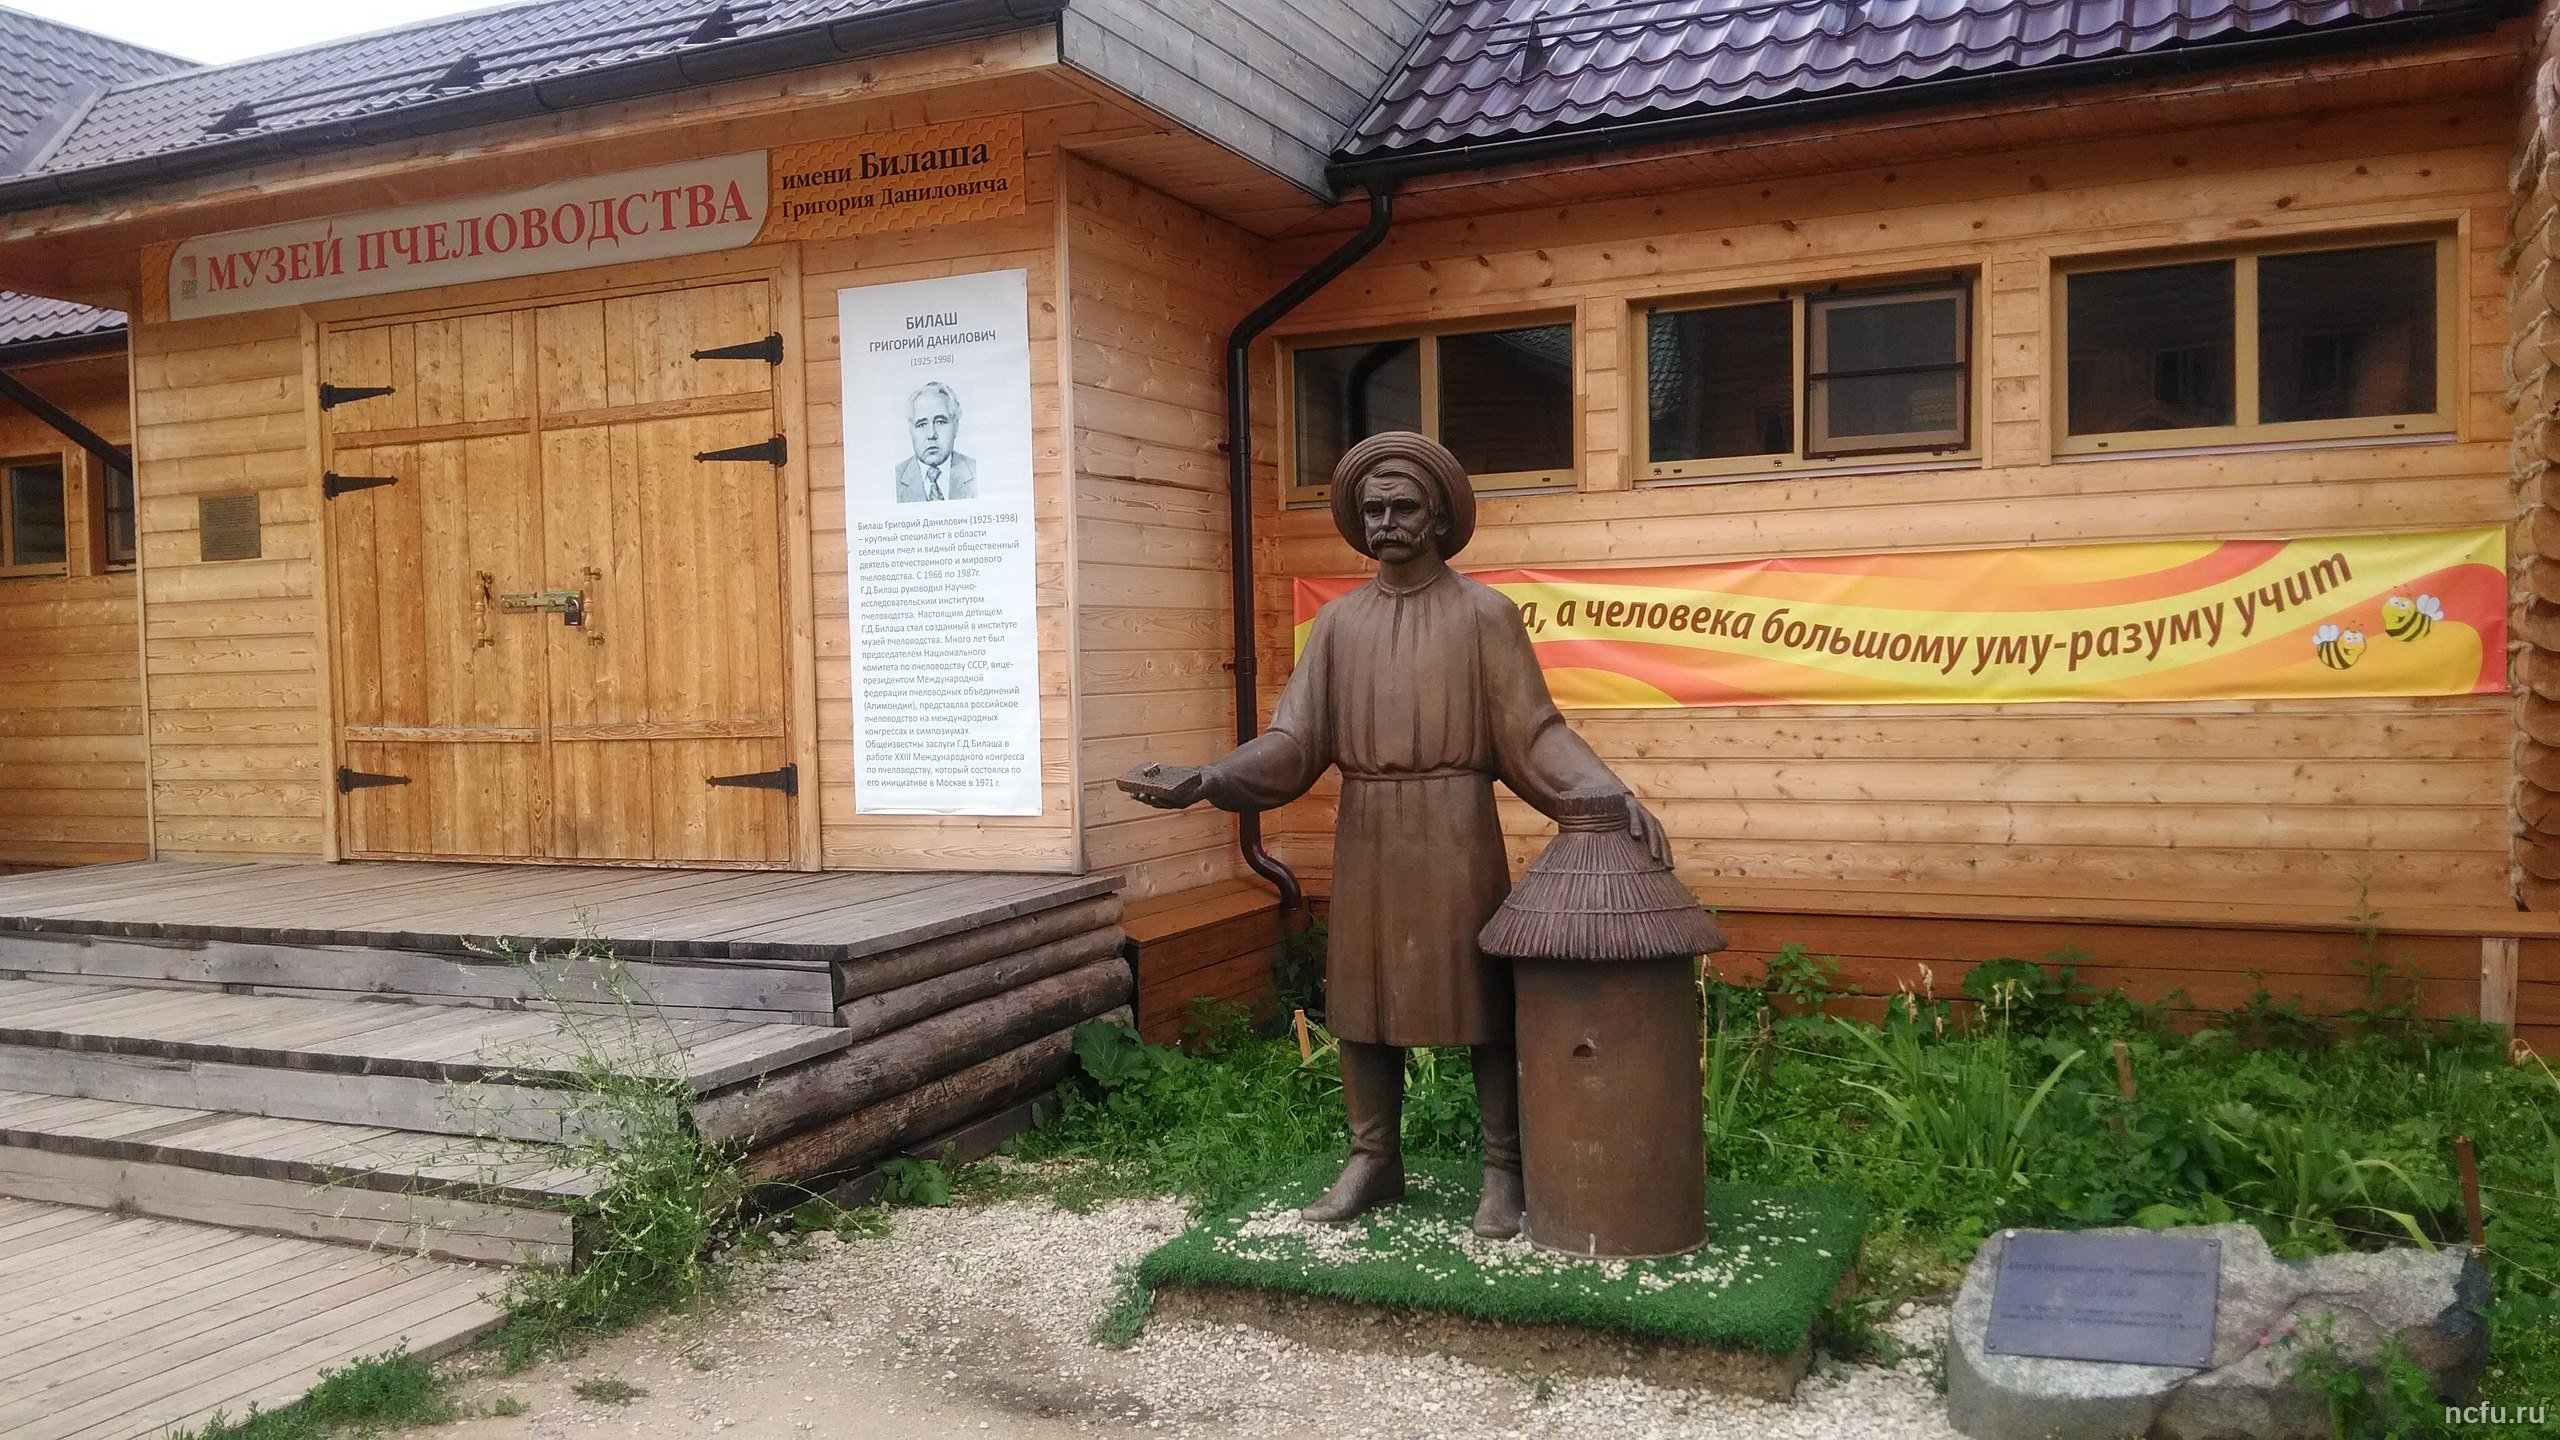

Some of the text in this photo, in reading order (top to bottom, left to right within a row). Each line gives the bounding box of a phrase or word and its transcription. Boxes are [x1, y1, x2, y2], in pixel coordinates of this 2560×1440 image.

[782, 142, 990, 190] имени Билаша
[782, 177, 1008, 222] Григория Даниловича
[357, 180, 752, 272] ПЧЕЛОВОДСТВА
[906, 312, 958, 330] БИЛАШ
[869, 330, 996, 352] ГРИГОРИЙ ДАНИЛОВИЧ
[910, 354, 954, 367] (1925-1998)
[858, 512, 1018, 531] Билаш Григорий Данилович (1925-1998)
[865, 532, 898, 545] крупный
[900, 532, 946, 544] специалист
[954, 527, 986, 539] области
[859, 548, 895, 558] селекции
[924, 542, 955, 555] видный
[958, 539, 1019, 554] общественный
[859, 561, 889, 571] деятель
[891, 558, 953, 568] отечественного
[962, 556, 1002, 567] мирового
[916, 570, 921, 579] С
[924, 569, 942, 579] 1966
[901, 585, 943, 595] руководил
[861, 596, 984, 610] исследовательским институтом
[918, 607, 963, 621] Настоящим
[965, 609, 1002, 619] детищем
[1516, 552, 2352, 676] а, а человека большому уму-разуму учит
[906, 624, 923, 632] стал
[925, 620, 969, 633] созданный
[978, 621, 1017, 632] институте
[861, 636, 885, 648] музей
[945, 633, 971, 643] Много
[988, 632, 1004, 642] был
[862, 646, 986, 661] председателем Национального
[912, 663, 965, 673] пчеловодству
[863, 673, 984, 686] президентом Международной
[863, 685, 1019, 699] федерации пчеловодных объединений
[920, 702, 968, 711] представлял
[971, 699, 1018, 711] российское
[865, 716, 918, 725] пчеловодство
[931, 715, 998, 724] международных
[865, 728, 907, 737] конгрессах
[865, 739, 923, 750] Общеизвестны
[925, 741, 955, 750] заслуги
[866, 752, 1024, 763] работе XXIII Международного конгресса
[935, 764, 968, 775] который
[881, 780, 927, 788] инициативе
[936, 777, 966, 786] Москве
[975, 778, 993, 786] 1971
